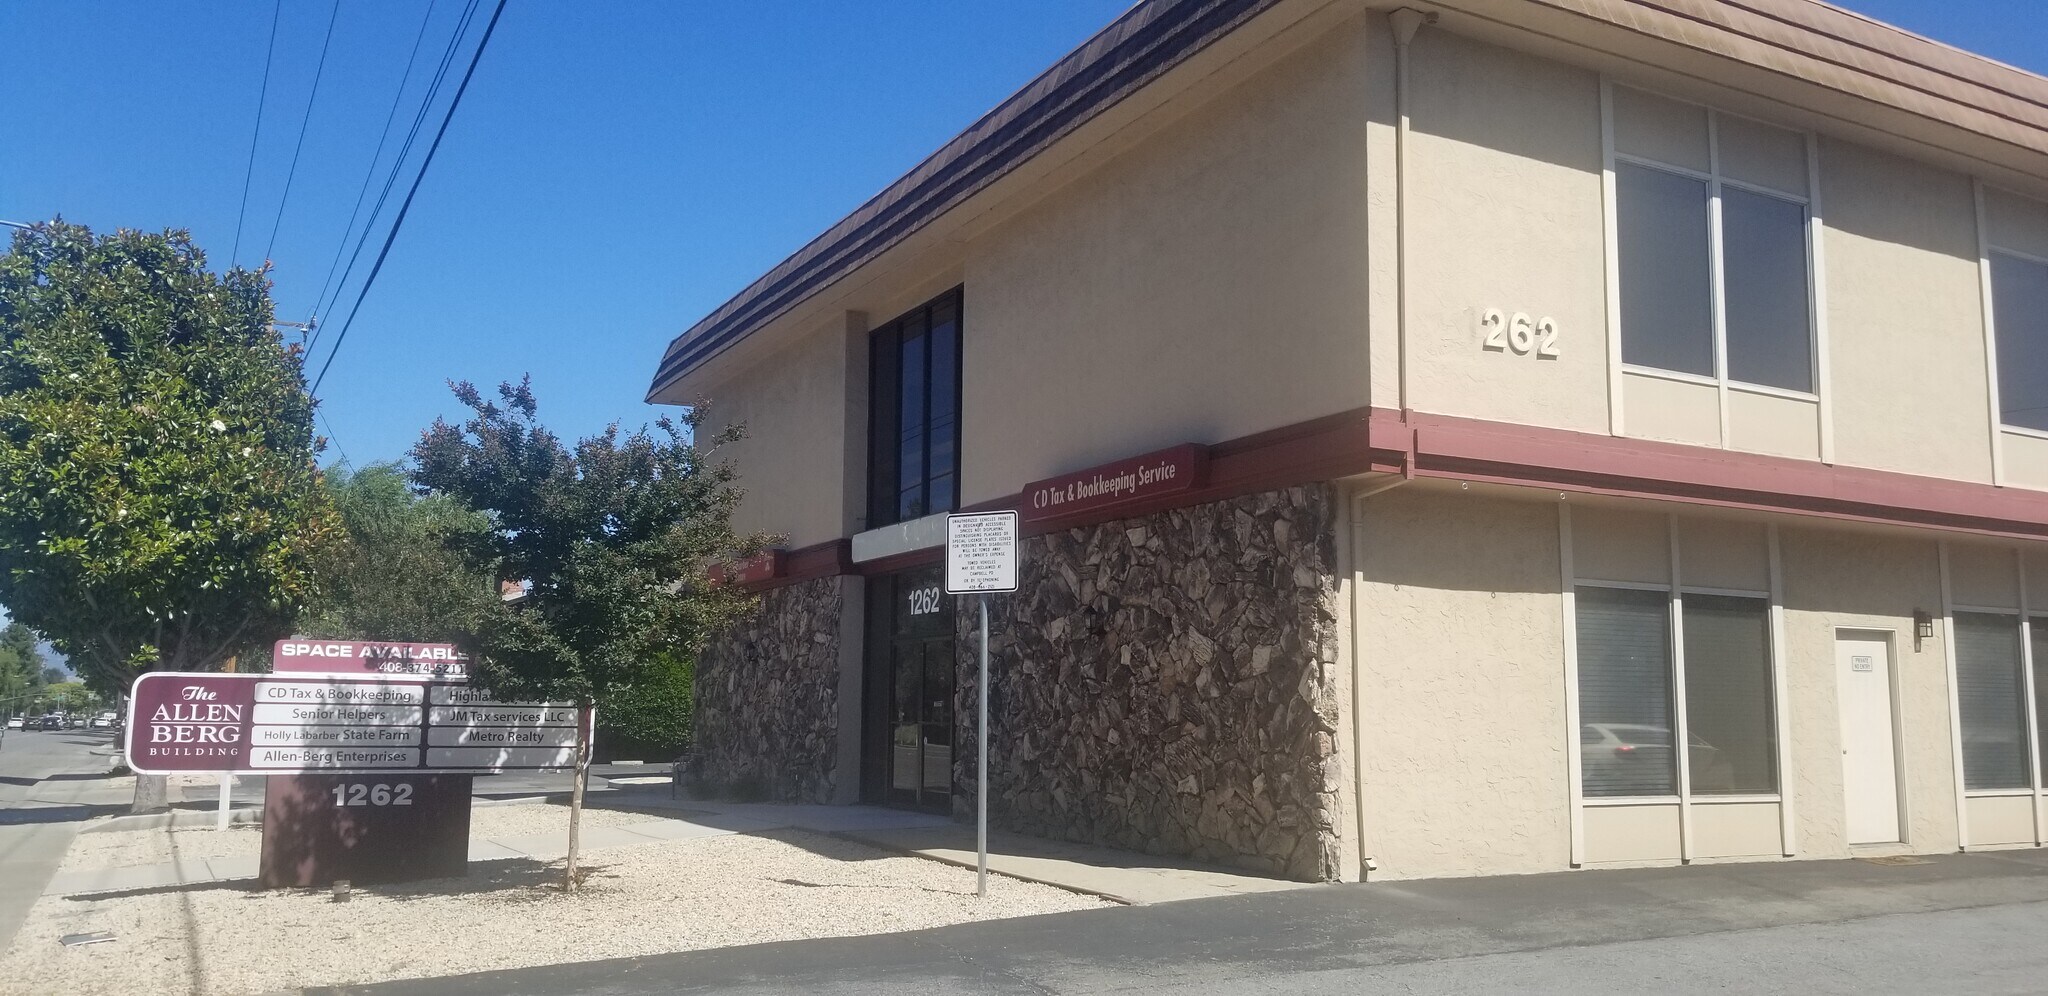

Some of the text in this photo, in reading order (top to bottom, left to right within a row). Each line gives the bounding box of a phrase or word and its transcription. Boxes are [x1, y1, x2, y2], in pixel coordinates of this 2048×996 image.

[1482, 308, 1560, 358] 262
[1034, 461, 1176, 508] C D Tax & Bookkeeping Service
[908, 586, 940, 615] 1262
[281, 644, 352, 658] SPACE
[379, 661, 466, 675] 408-374-5211
[182, 686, 217, 701] The
[268, 688, 411, 703] CD Tax & Bookkeeping
[449, 691, 493, 704] Highla
[151, 703, 243, 721] ALLEN
[292, 709, 386, 722] Senior Helpers
[450, 712, 564, 722] JM Tax services LLC
[150, 725, 241, 743] BERG
[264, 729, 410, 742] Holly Labarber State Farm
[469, 732, 544, 744] Metro Realty
[149, 747, 238, 756] BUILDING
[264, 751, 407, 764] Allen-Berg Enterprises
[332, 783, 413, 807] 1262
